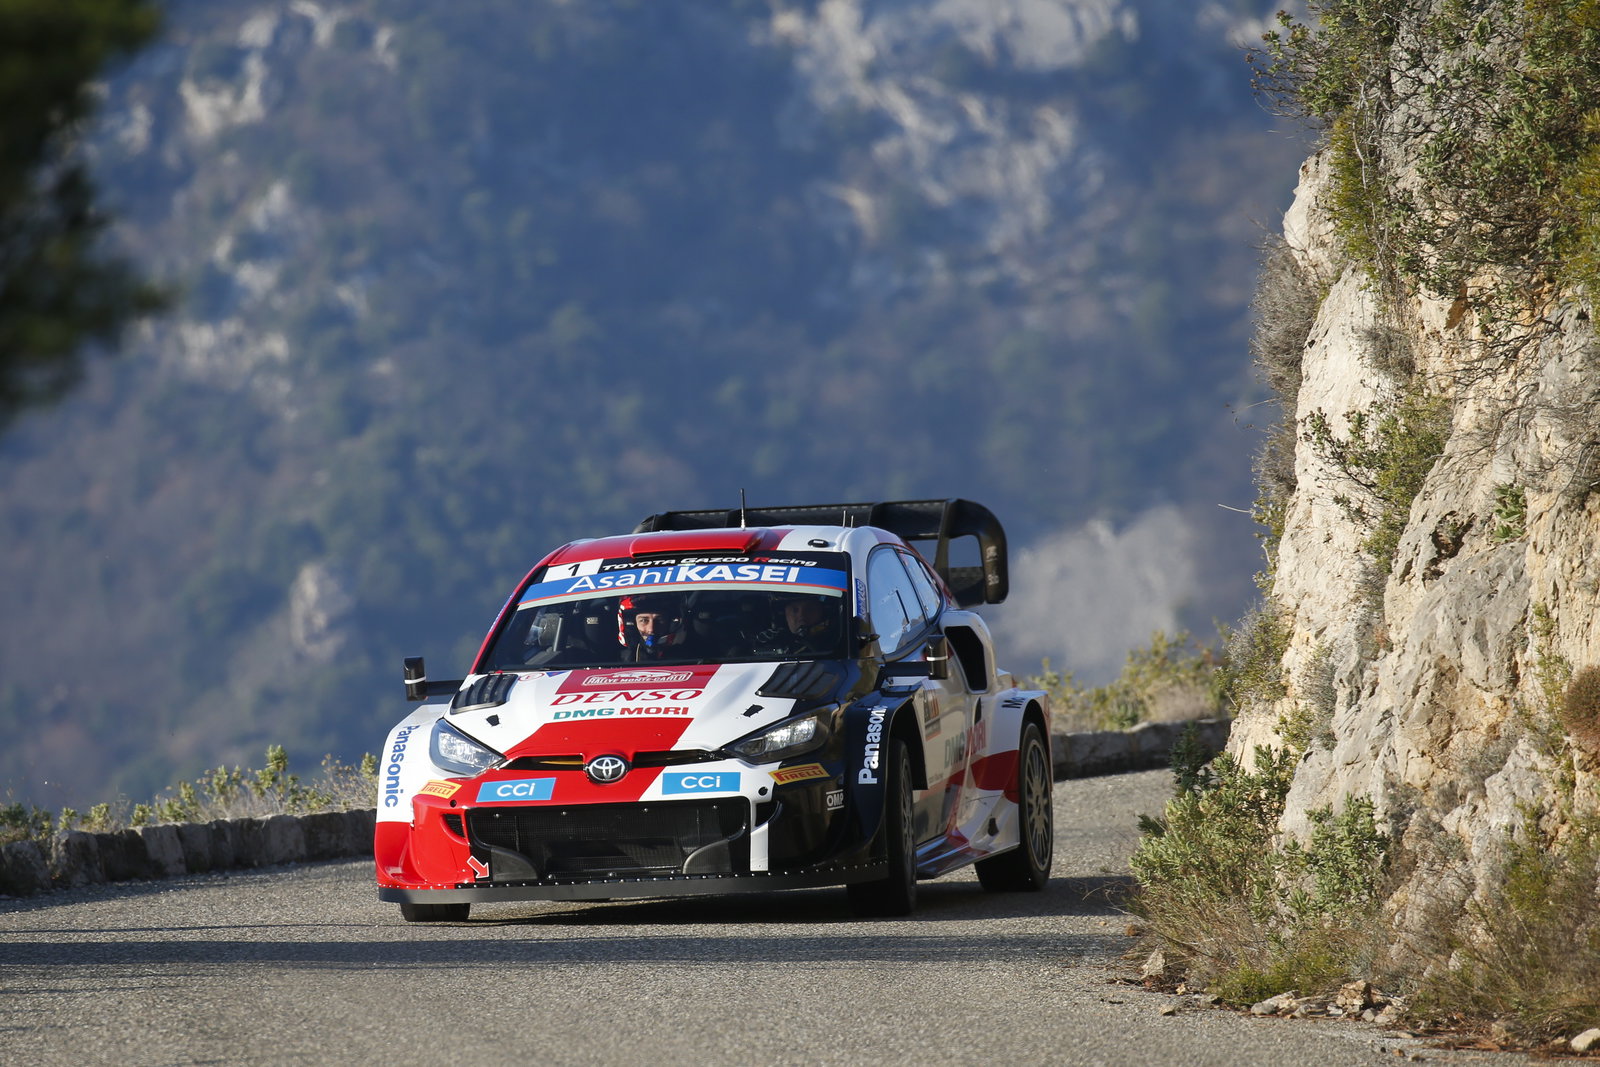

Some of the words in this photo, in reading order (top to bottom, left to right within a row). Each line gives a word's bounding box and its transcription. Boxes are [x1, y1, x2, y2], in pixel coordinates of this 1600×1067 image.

[568, 563, 581, 577] 1
[602, 559, 676, 571] TOYOTA
[683, 556, 750, 565] GAZOO
[753, 556, 818, 567] Racing
[550, 689, 704, 706] DENSO
[553, 707, 615, 720] DMG
[619, 706, 690, 716] MORI
[858, 705, 888, 785] Panasonic
[384, 724, 420, 808] Panasonic
[774, 765, 824, 782] PIRELLI
[421, 781, 456, 796] PIRELLI
[826, 793, 844, 807] OMP
